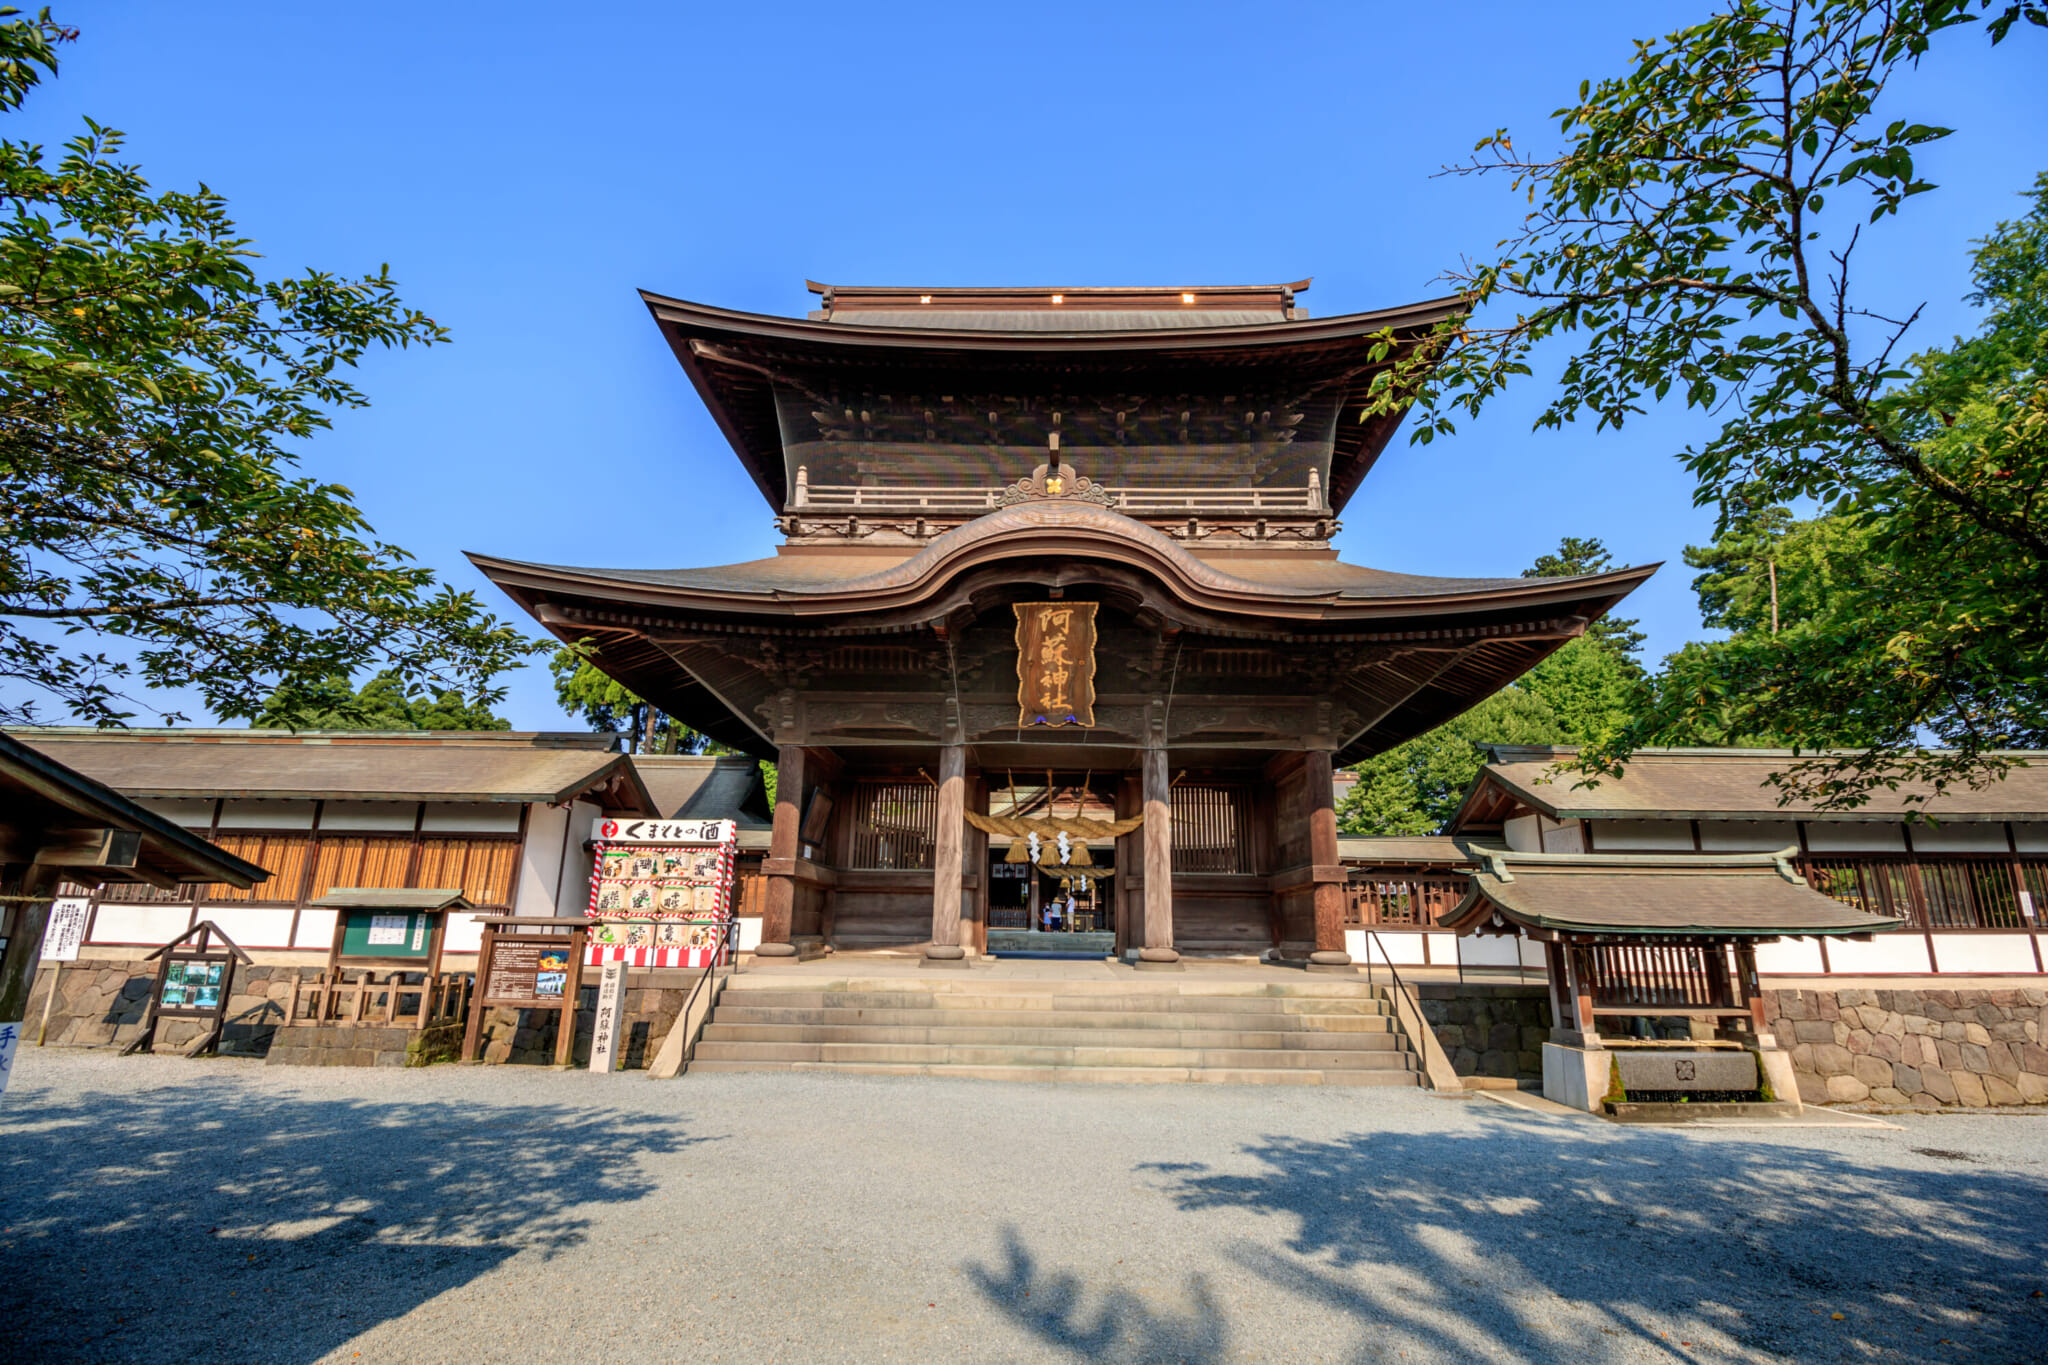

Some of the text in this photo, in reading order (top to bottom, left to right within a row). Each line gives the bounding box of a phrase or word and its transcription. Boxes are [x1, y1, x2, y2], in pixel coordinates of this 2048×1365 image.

[1039, 608, 1075, 709] 阿蘇神社
[625, 821, 722, 840] くまもとの酒
